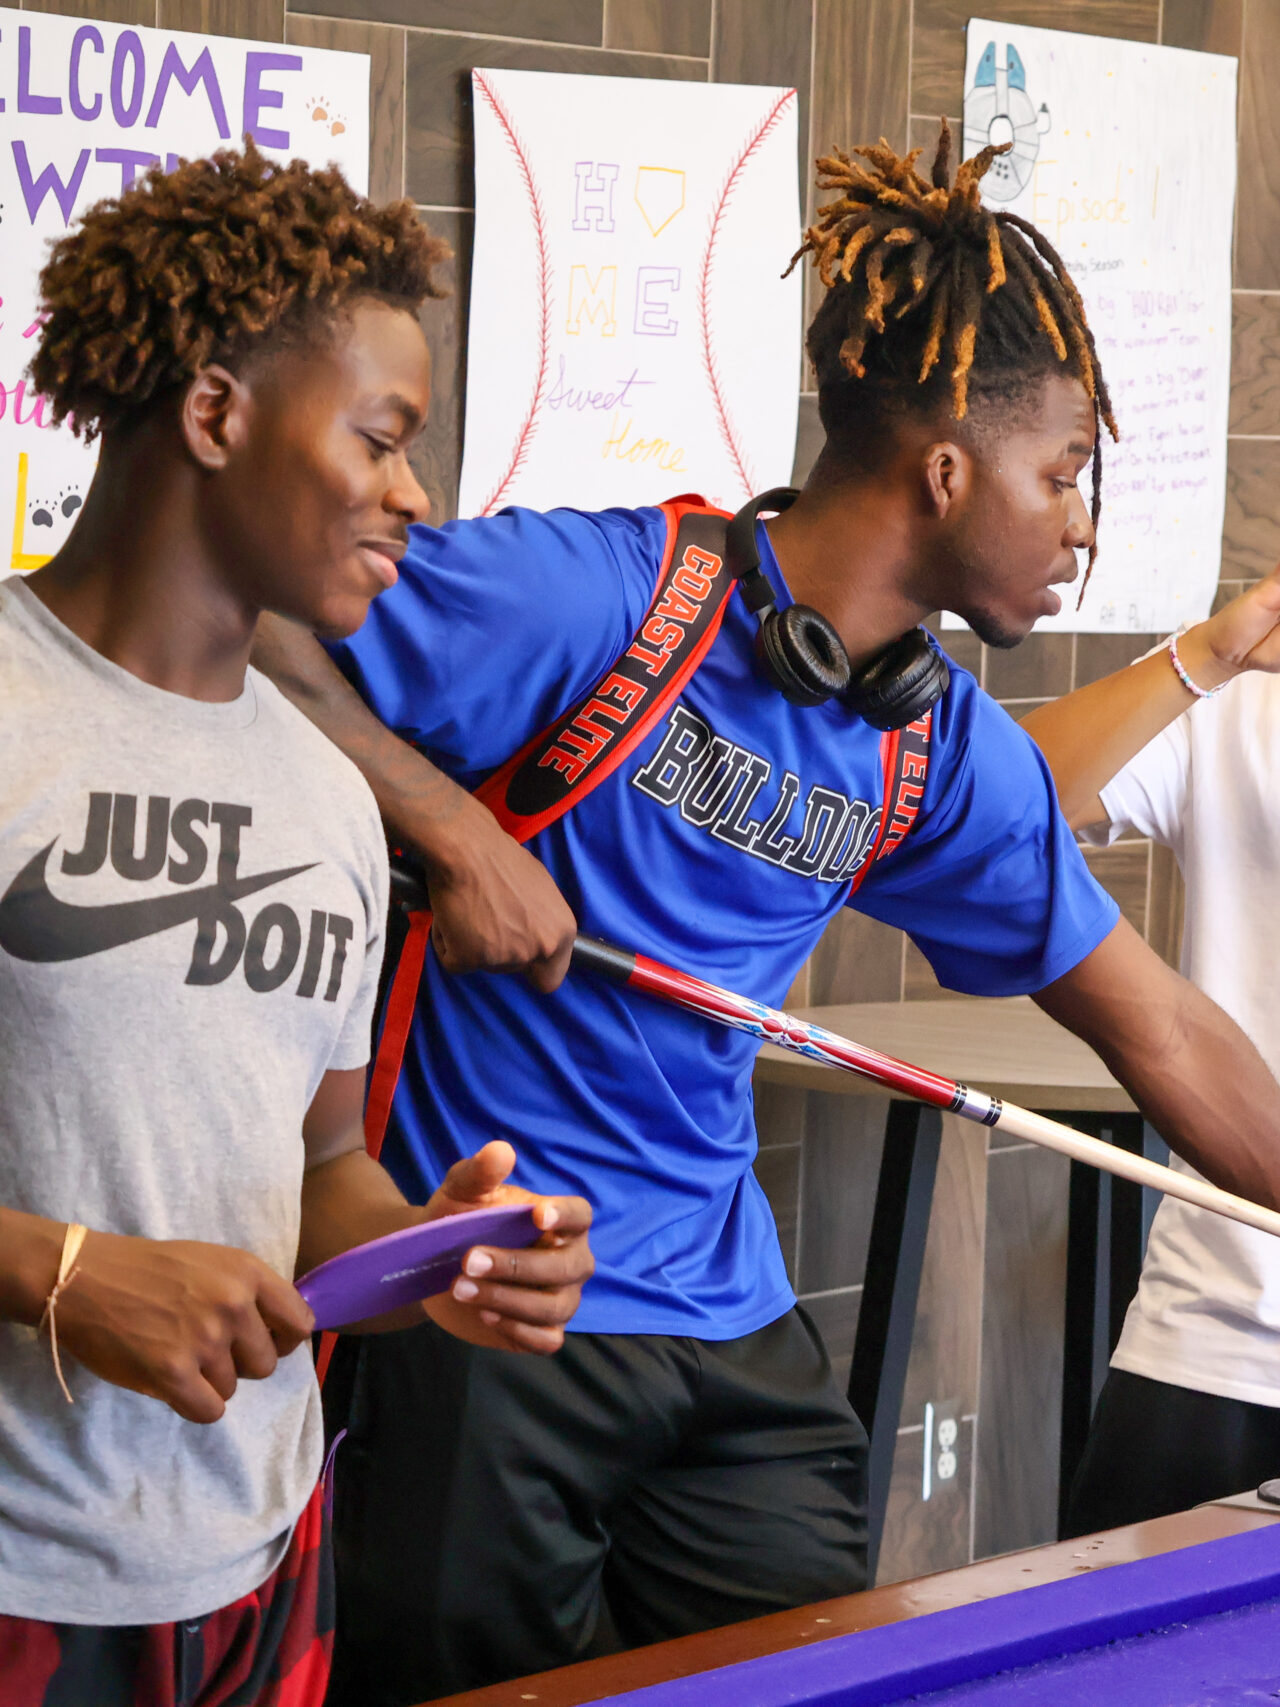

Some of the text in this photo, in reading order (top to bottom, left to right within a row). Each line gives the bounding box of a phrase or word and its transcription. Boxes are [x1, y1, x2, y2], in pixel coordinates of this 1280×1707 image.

[0, 25, 303, 150] LCOME
[1032, 160, 1131, 247] Episode
[544, 353, 657, 411] Sweet
[601, 410, 688, 473] Home
[537, 543, 723, 785] COAST ELITE
[60, 791, 253, 891] JUST
